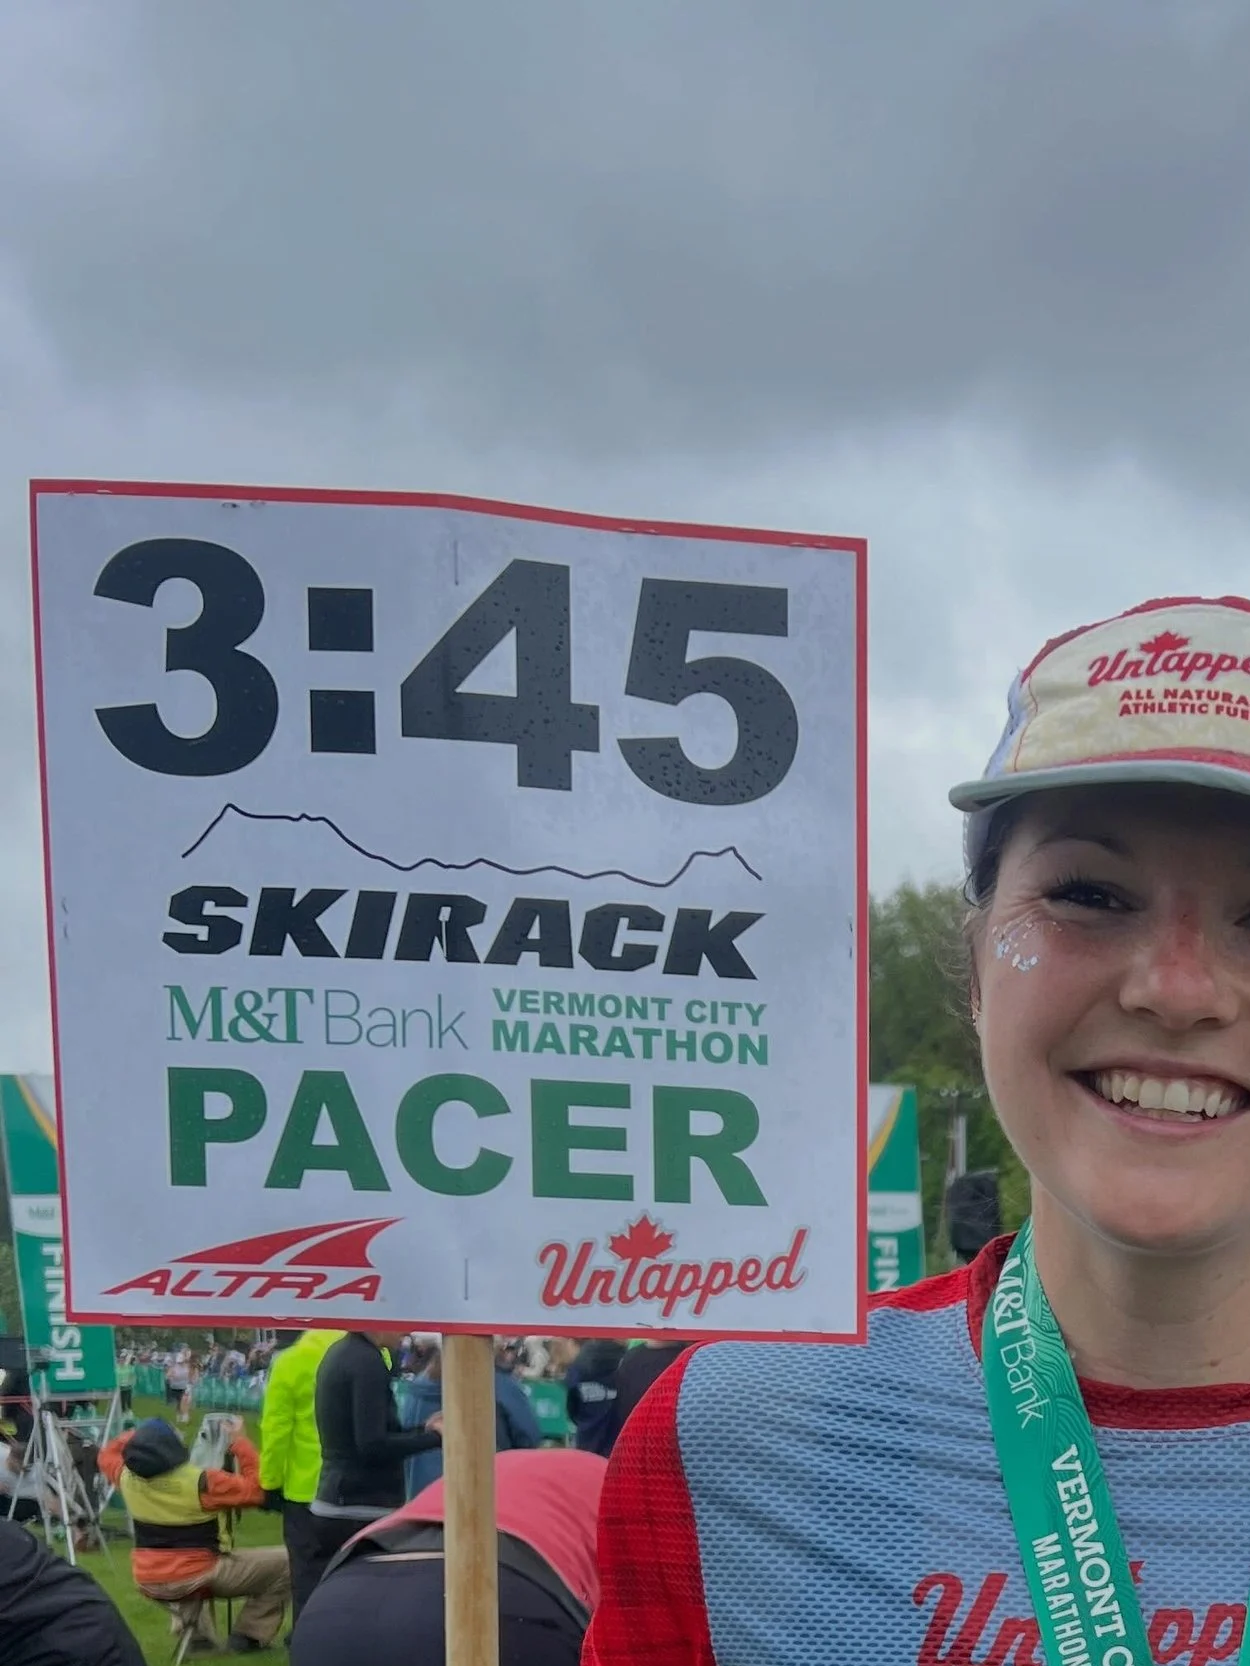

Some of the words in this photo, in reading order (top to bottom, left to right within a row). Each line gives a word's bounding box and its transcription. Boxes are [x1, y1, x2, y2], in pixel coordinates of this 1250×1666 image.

[93, 538, 799, 806] 3:45
[1119, 702, 1208, 717] ATHLETIC
[1120, 688, 1155, 701] ALL
[162, 885, 767, 981] SKIRACK
[163, 985, 314, 1044] M&T
[323, 989, 469, 1051] Bank
[492, 987, 673, 1023] VERMONT
[684, 1001, 769, 1026] CITY
[492, 1019, 770, 1066] MARATHON
[166, 1065, 770, 1207] PACER
[100, 1269, 382, 1302] ALTRA
[873, 1237, 901, 1291] FIN
[993, 1254, 1032, 1339] M&T
[41, 1241, 86, 1381] FINISH
[1000, 1339, 1051, 1429] Bank
[1052, 1443, 1127, 1639] VERMONT
